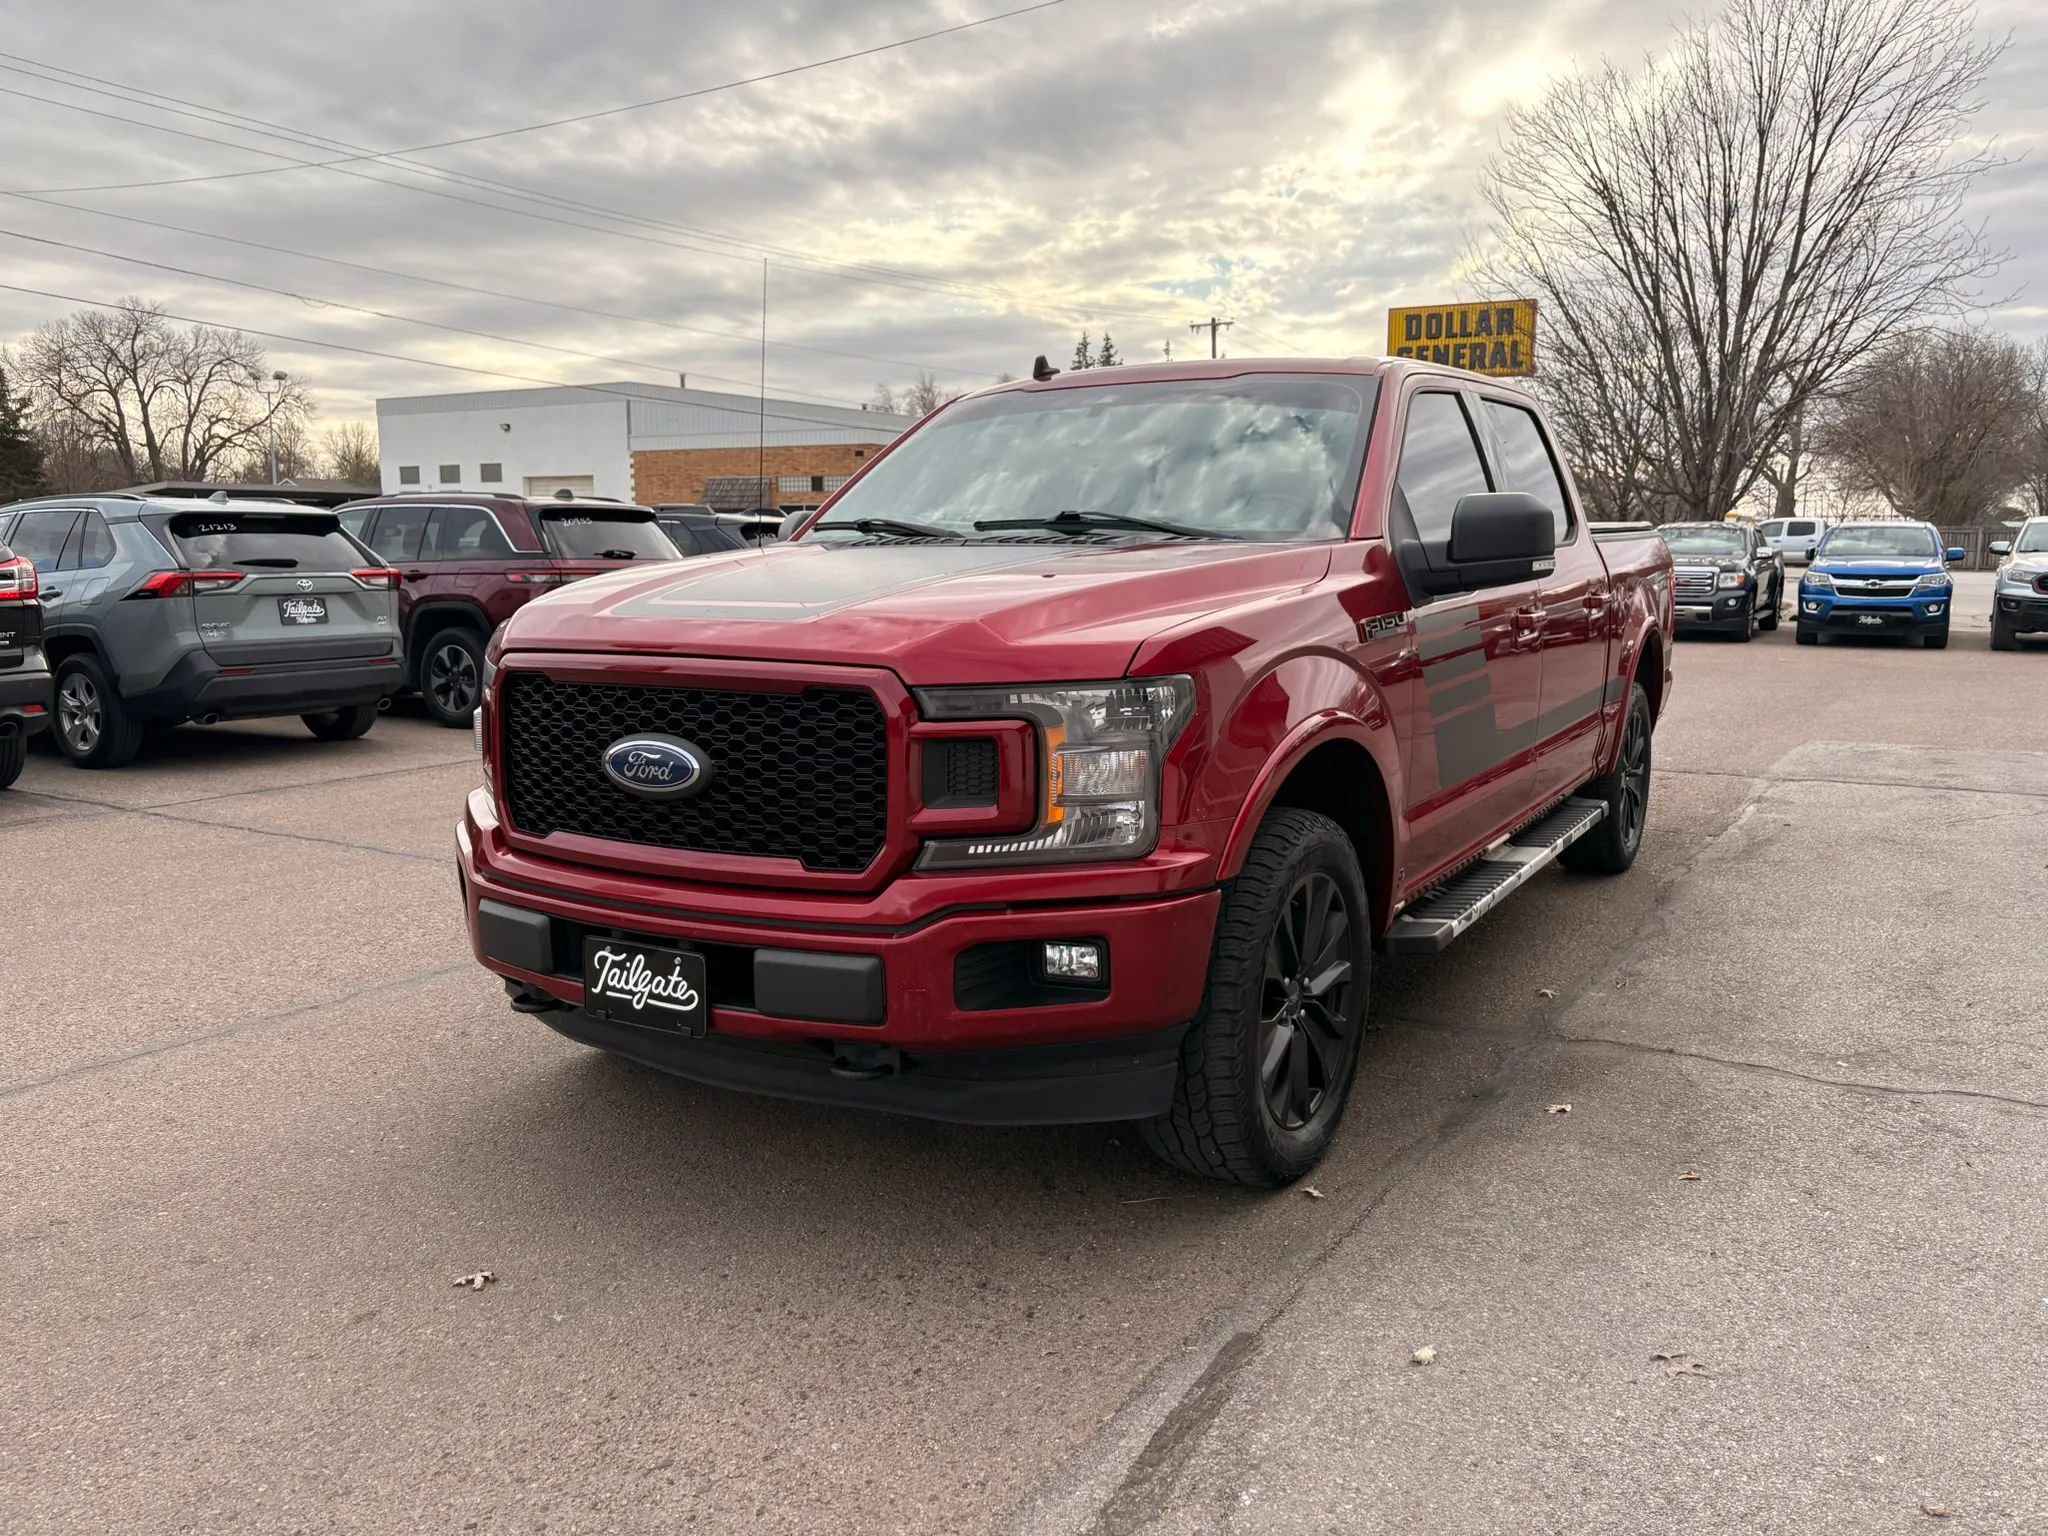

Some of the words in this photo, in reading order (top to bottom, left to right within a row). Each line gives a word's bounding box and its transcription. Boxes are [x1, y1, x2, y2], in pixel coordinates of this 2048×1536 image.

[1405, 308, 1514, 341] DOLLAR
[198, 523, 237, 532] 21213
[283, 600, 325, 617] Tailgate
[623, 750, 674, 782] Ford
[591, 949, 699, 1010] Tailgate
